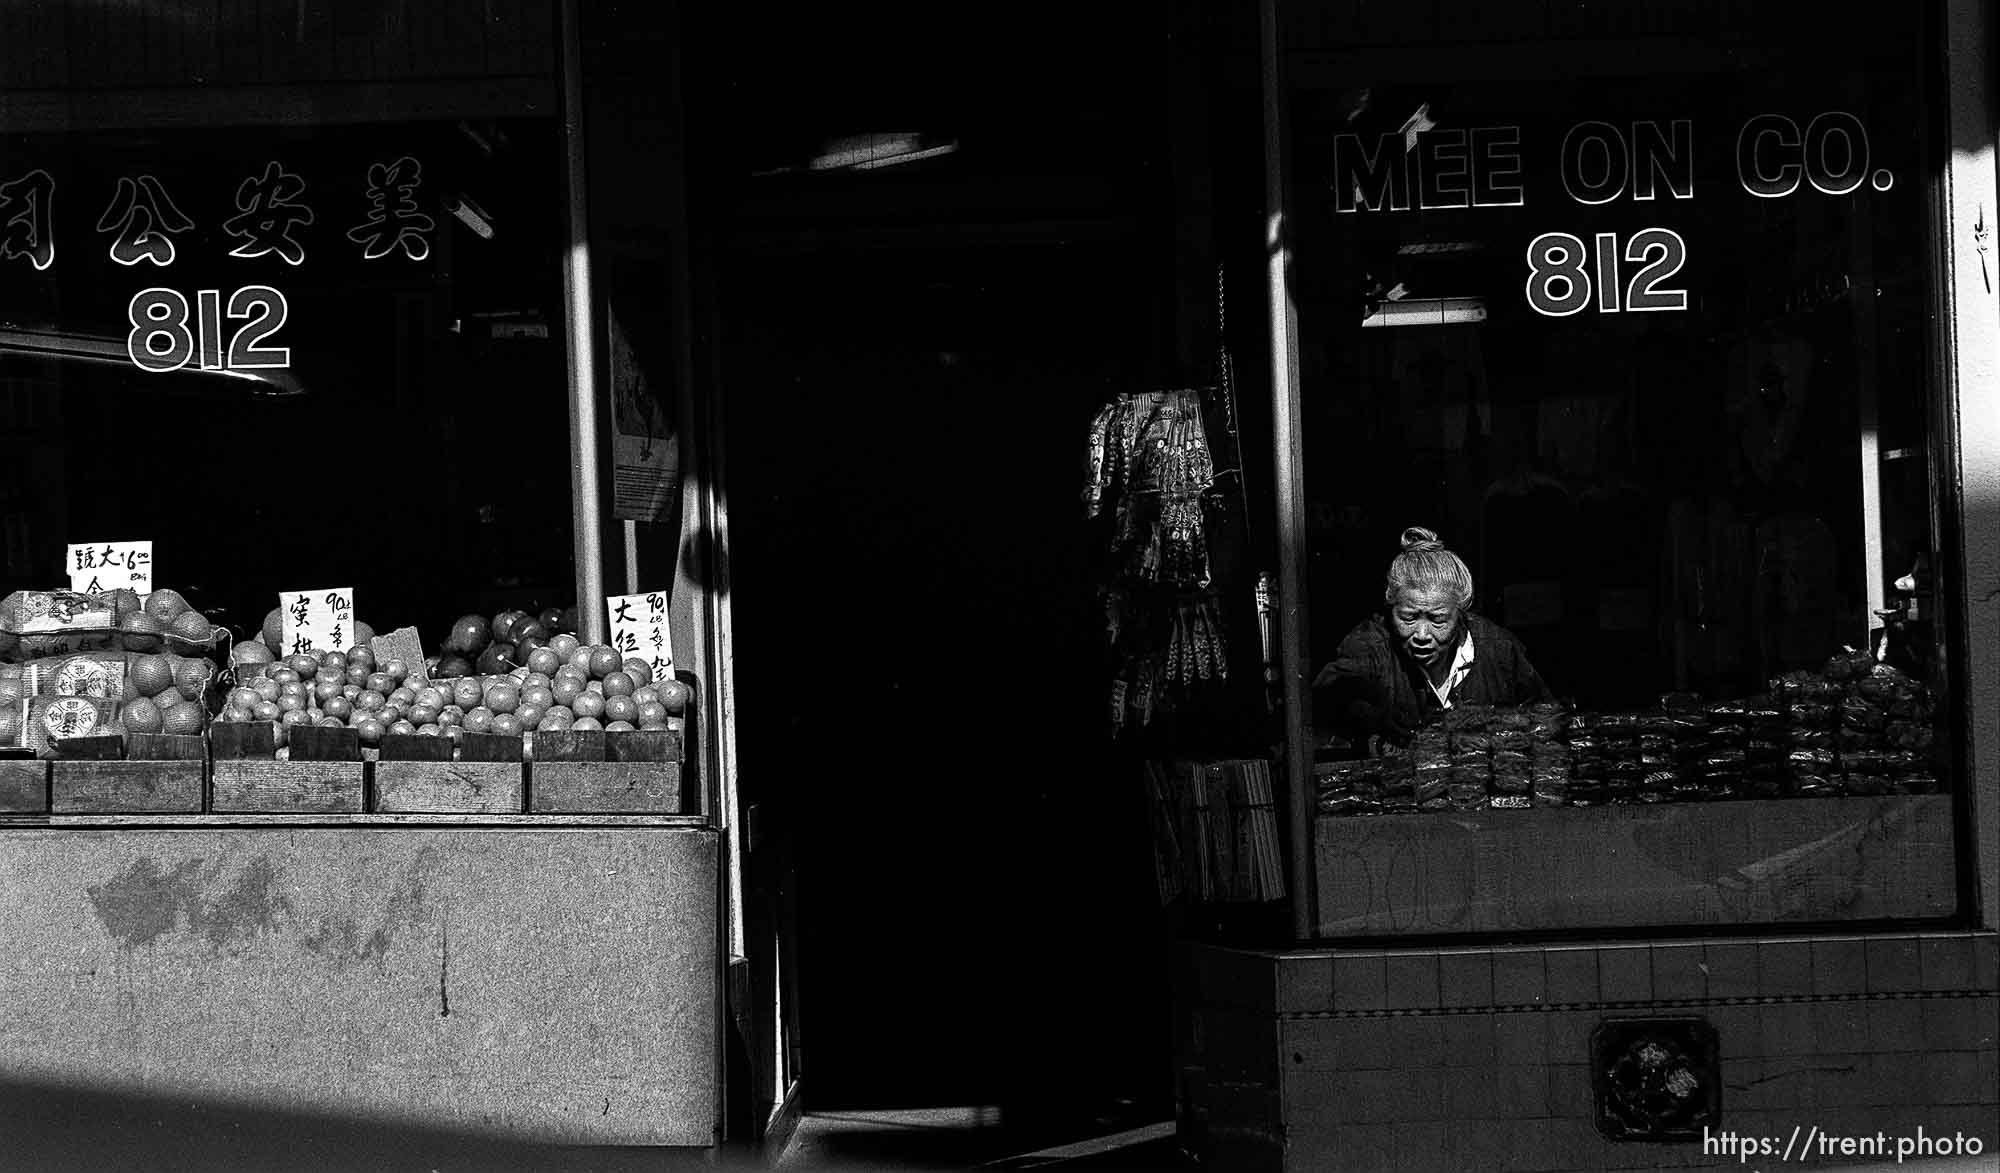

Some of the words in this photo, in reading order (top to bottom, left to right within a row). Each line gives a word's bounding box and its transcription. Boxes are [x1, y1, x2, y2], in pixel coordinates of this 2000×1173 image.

[1333, 125, 1525, 213] MEE
[1560, 119, 1695, 205] ON
[1736, 111, 1894, 198] CO.
[1526, 227, 1688, 318] 812
[127, 284, 291, 373] 812
